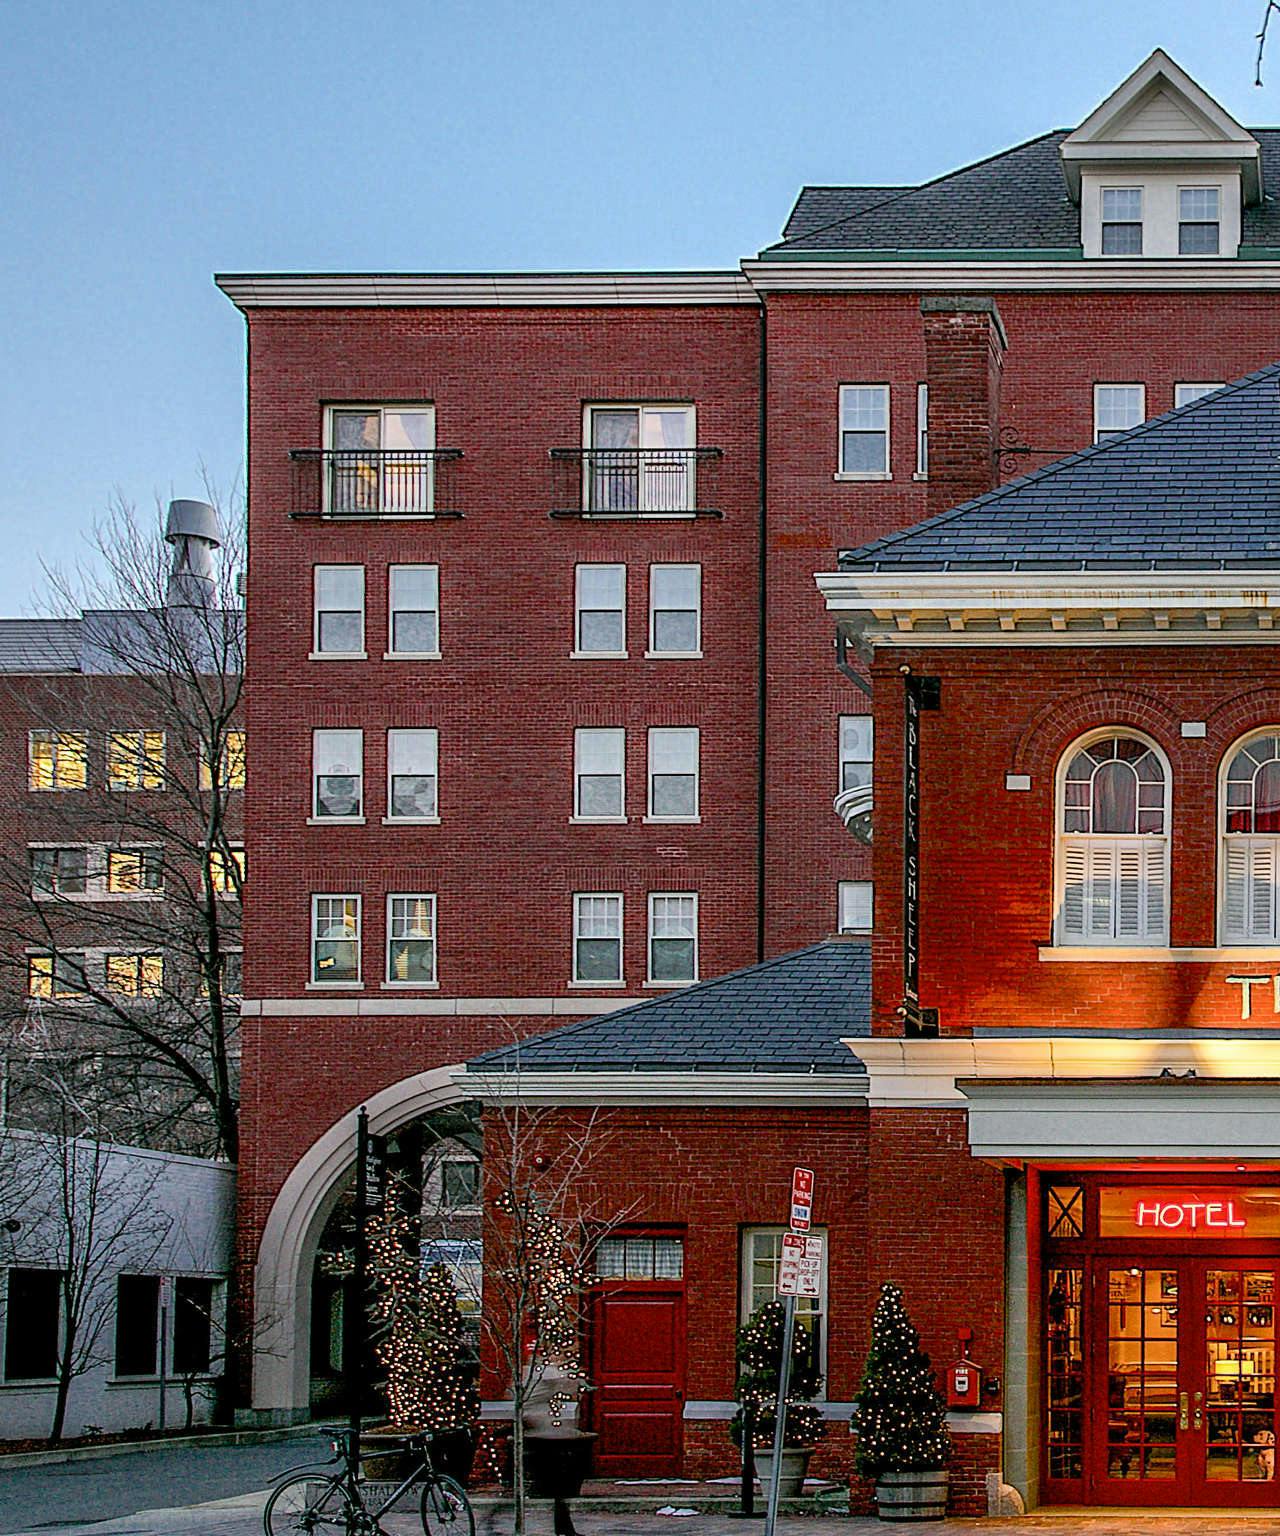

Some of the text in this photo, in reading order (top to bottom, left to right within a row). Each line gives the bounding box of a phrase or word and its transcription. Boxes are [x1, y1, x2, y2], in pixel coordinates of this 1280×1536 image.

[907, 722, 917, 842] BLACK
[907, 856, 917, 977] SHEEP
[1136, 1202, 1246, 1228] HOTEL
